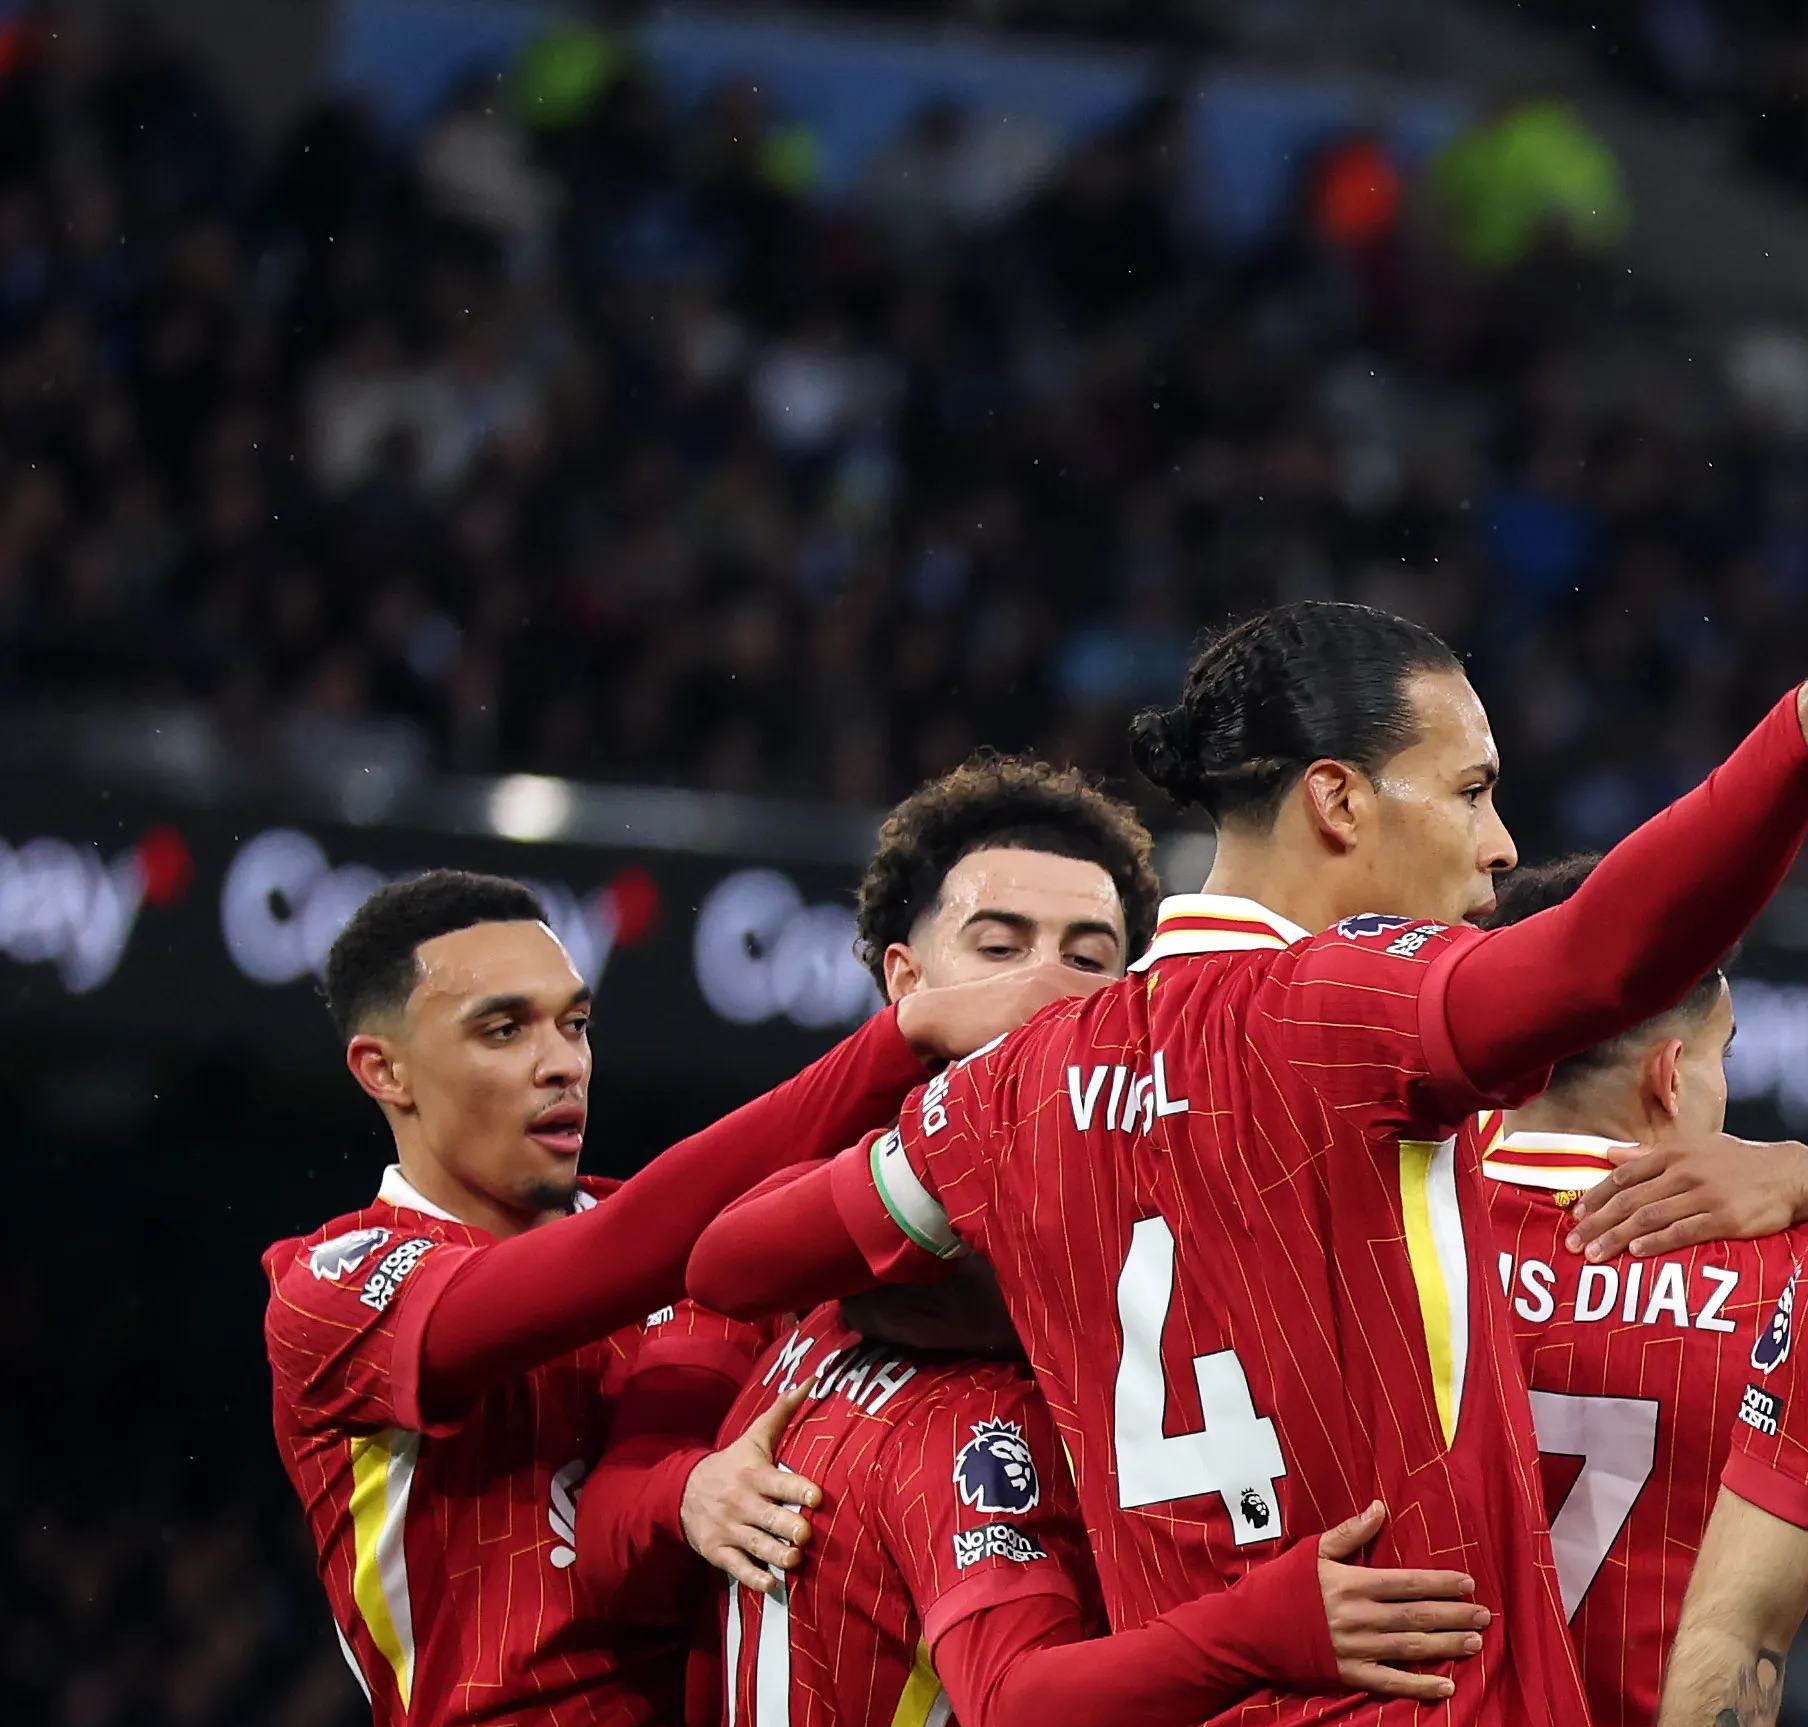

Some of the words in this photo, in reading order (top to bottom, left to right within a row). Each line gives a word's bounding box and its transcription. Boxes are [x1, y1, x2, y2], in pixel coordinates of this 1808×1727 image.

[1574, 1262, 1740, 1333] DIAZ
[1113, 1216, 1288, 1546] 4
[953, 1531, 985, 1553] No
[986, 1525, 1032, 1551] room
[1529, 1389, 1660, 1625] 7
[956, 1546, 984, 1570] for
[986, 1540, 1048, 1562] racism
